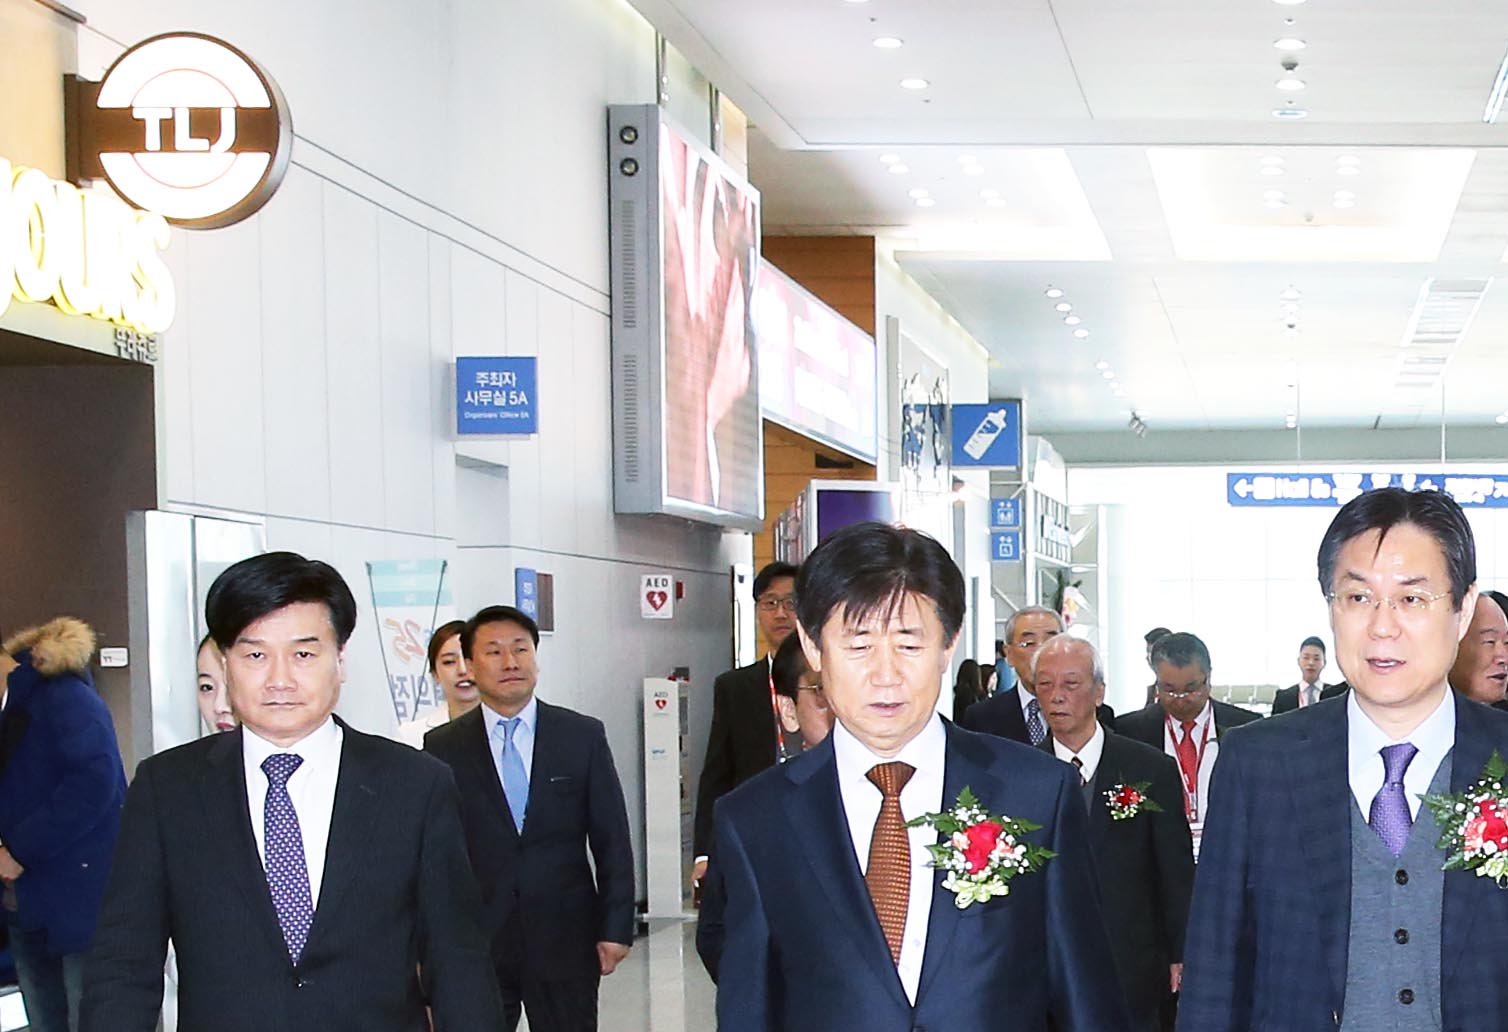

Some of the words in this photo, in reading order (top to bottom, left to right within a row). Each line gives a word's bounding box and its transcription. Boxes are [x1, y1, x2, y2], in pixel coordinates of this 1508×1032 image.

[131, 106, 237, 153] TLJ
[475, 371, 517, 388] 주최자
[464, 389, 507, 406] 사무실
[508, 390, 529, 406] 5A
[646, 577, 669, 588] AED
